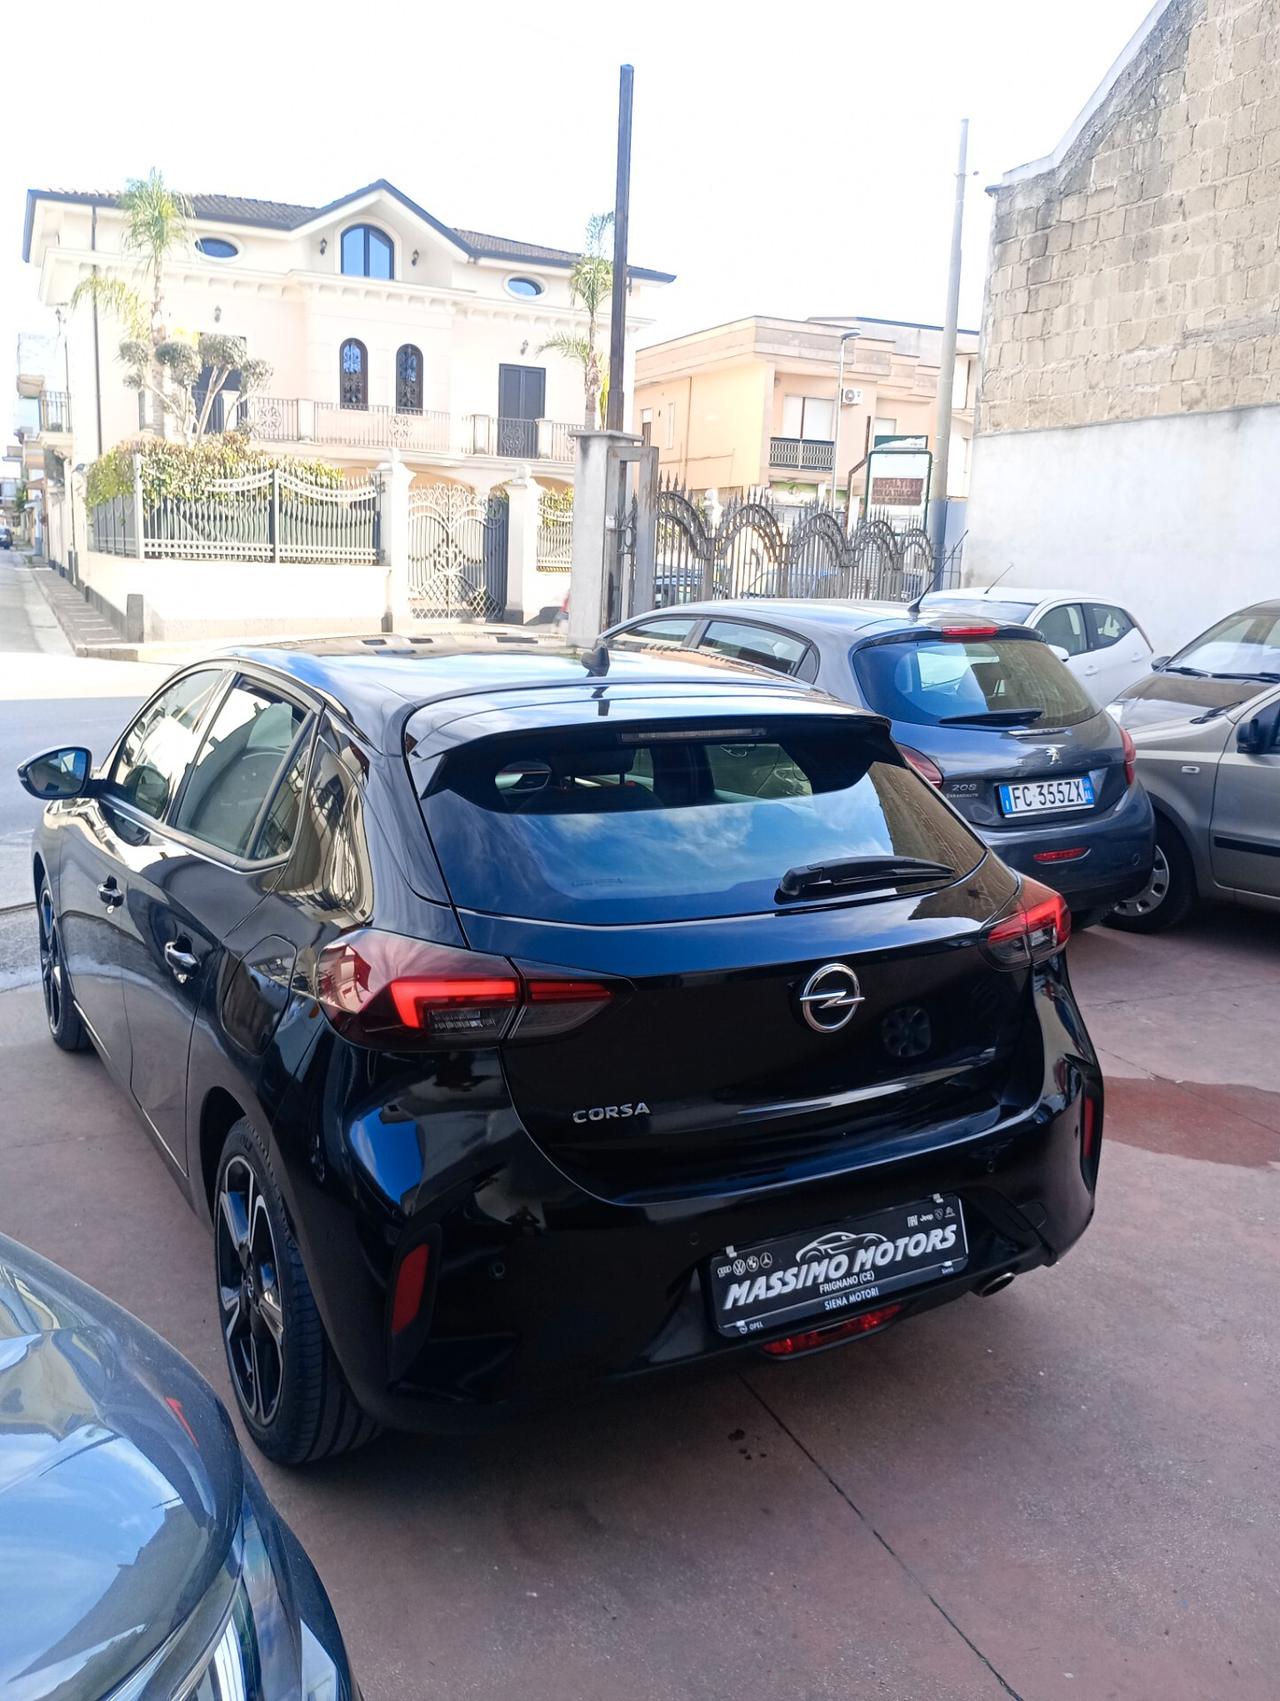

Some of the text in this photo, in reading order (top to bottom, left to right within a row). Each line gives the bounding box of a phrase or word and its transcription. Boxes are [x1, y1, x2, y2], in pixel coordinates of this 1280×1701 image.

[1011, 780, 1084, 809] FC 355ZX
[572, 1102, 650, 1124] CORSA
[723, 1224, 957, 1310] MASSIMO MOTORS
[819, 1270, 875, 1294] FRIGNANO (CE)
[824, 1287, 880, 1311] SIENA MOTORI
[749, 1321, 764, 1331] OPEL
